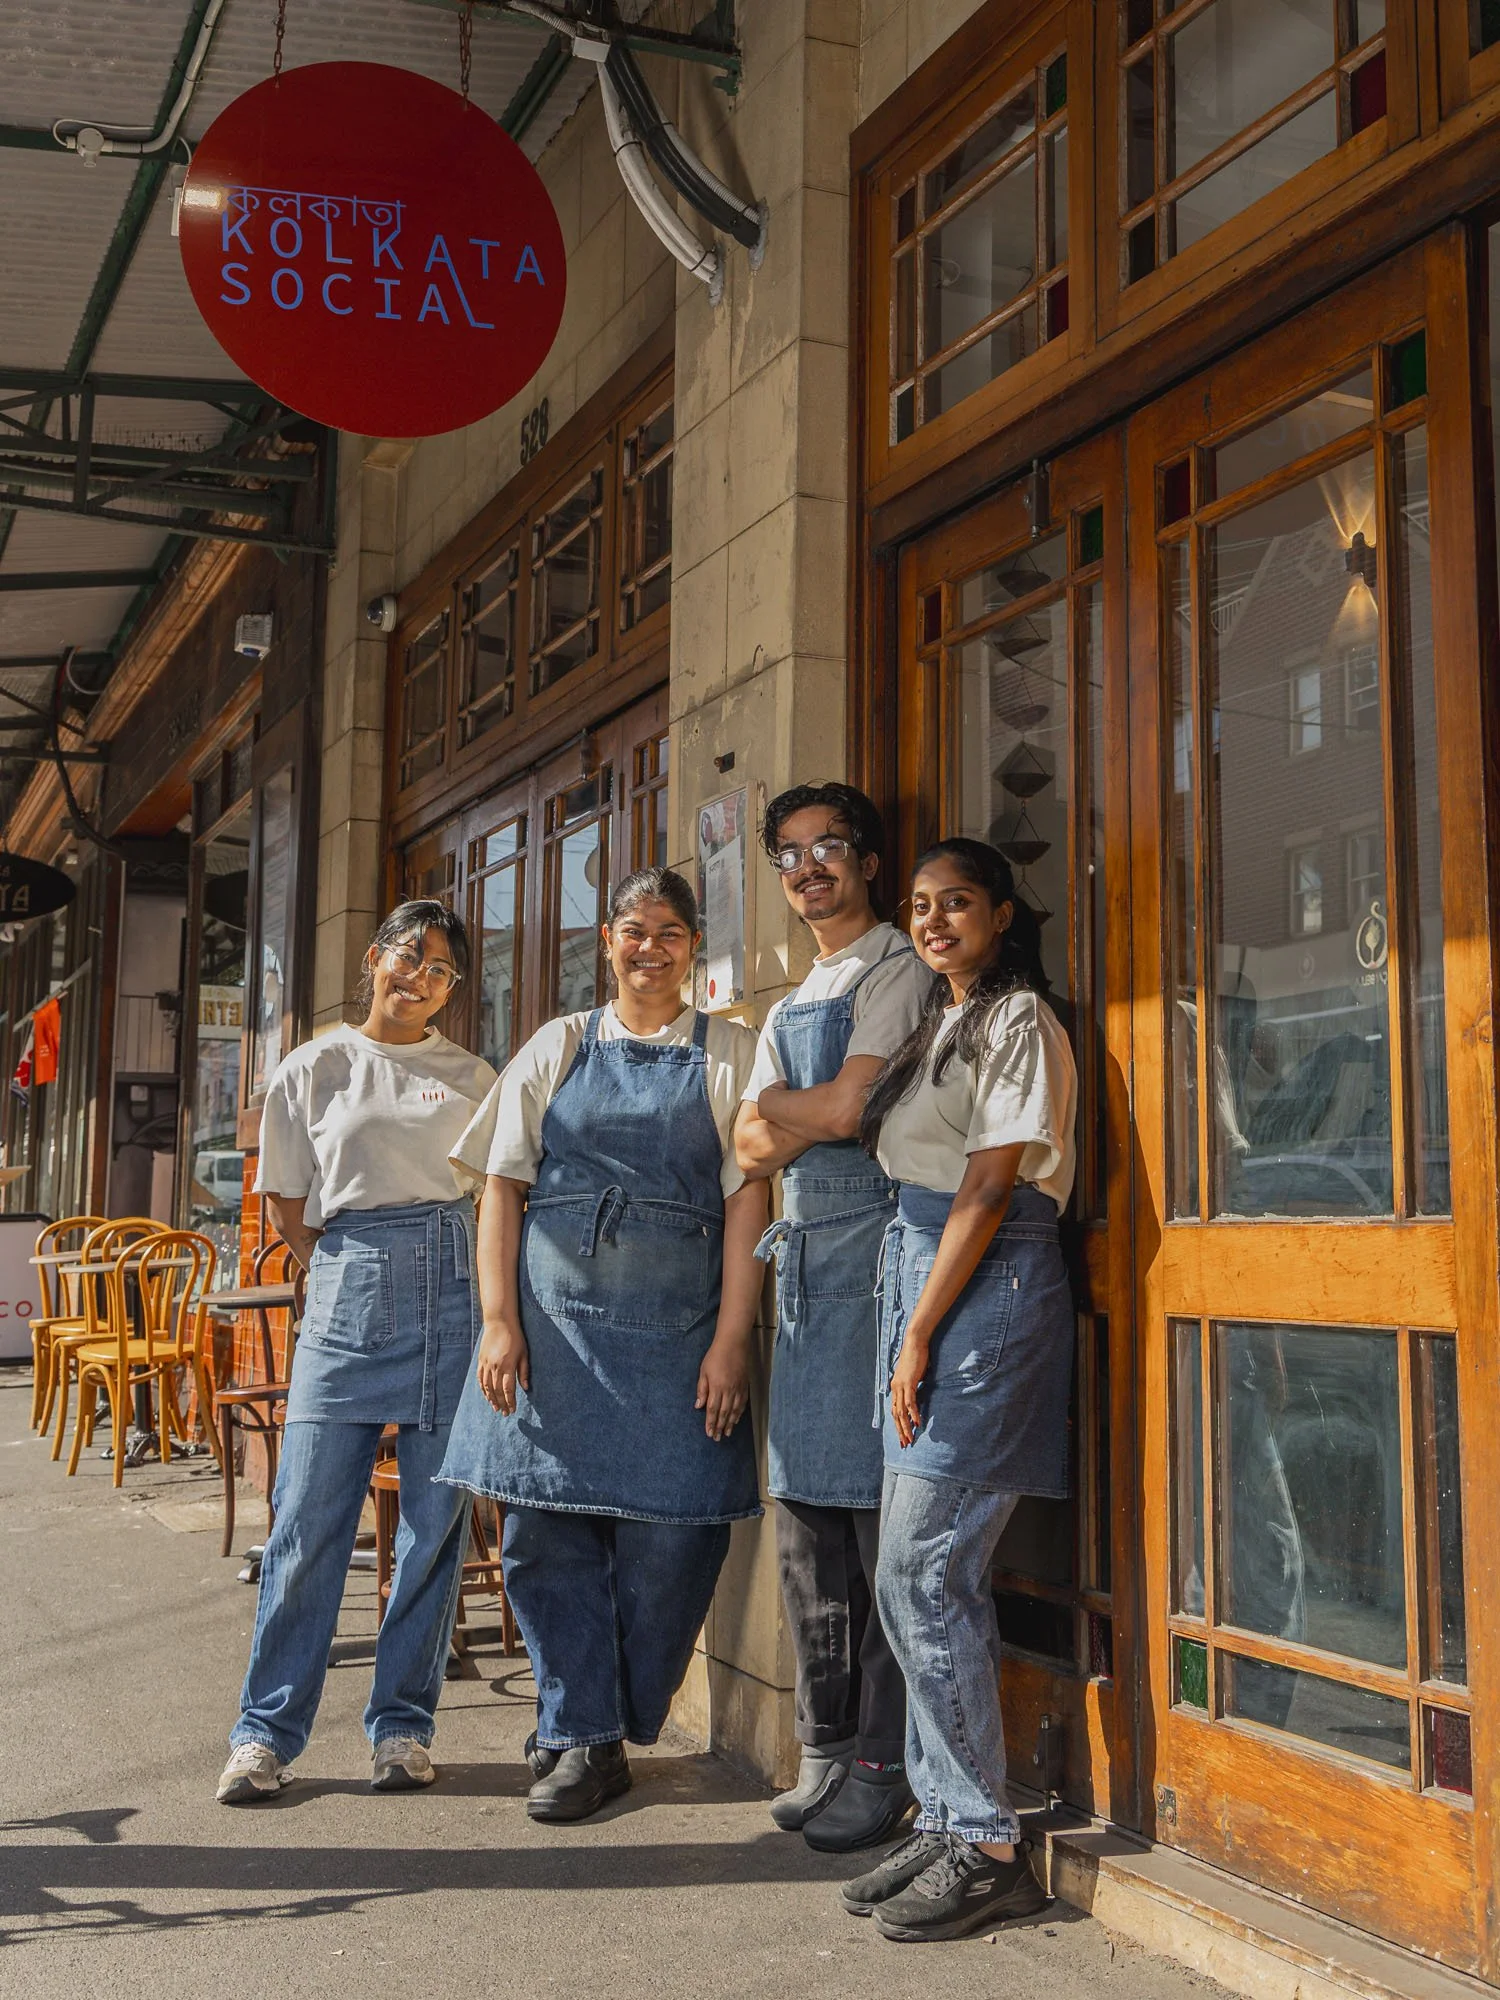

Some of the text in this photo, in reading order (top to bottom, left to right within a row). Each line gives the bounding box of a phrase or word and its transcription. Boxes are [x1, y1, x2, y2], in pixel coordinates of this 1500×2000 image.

[224, 184, 408, 231] কলকাতা
[221, 210, 546, 287] KOLKATA
[220, 262, 495, 330] SOCIAL
[521, 397, 549, 466] 528
